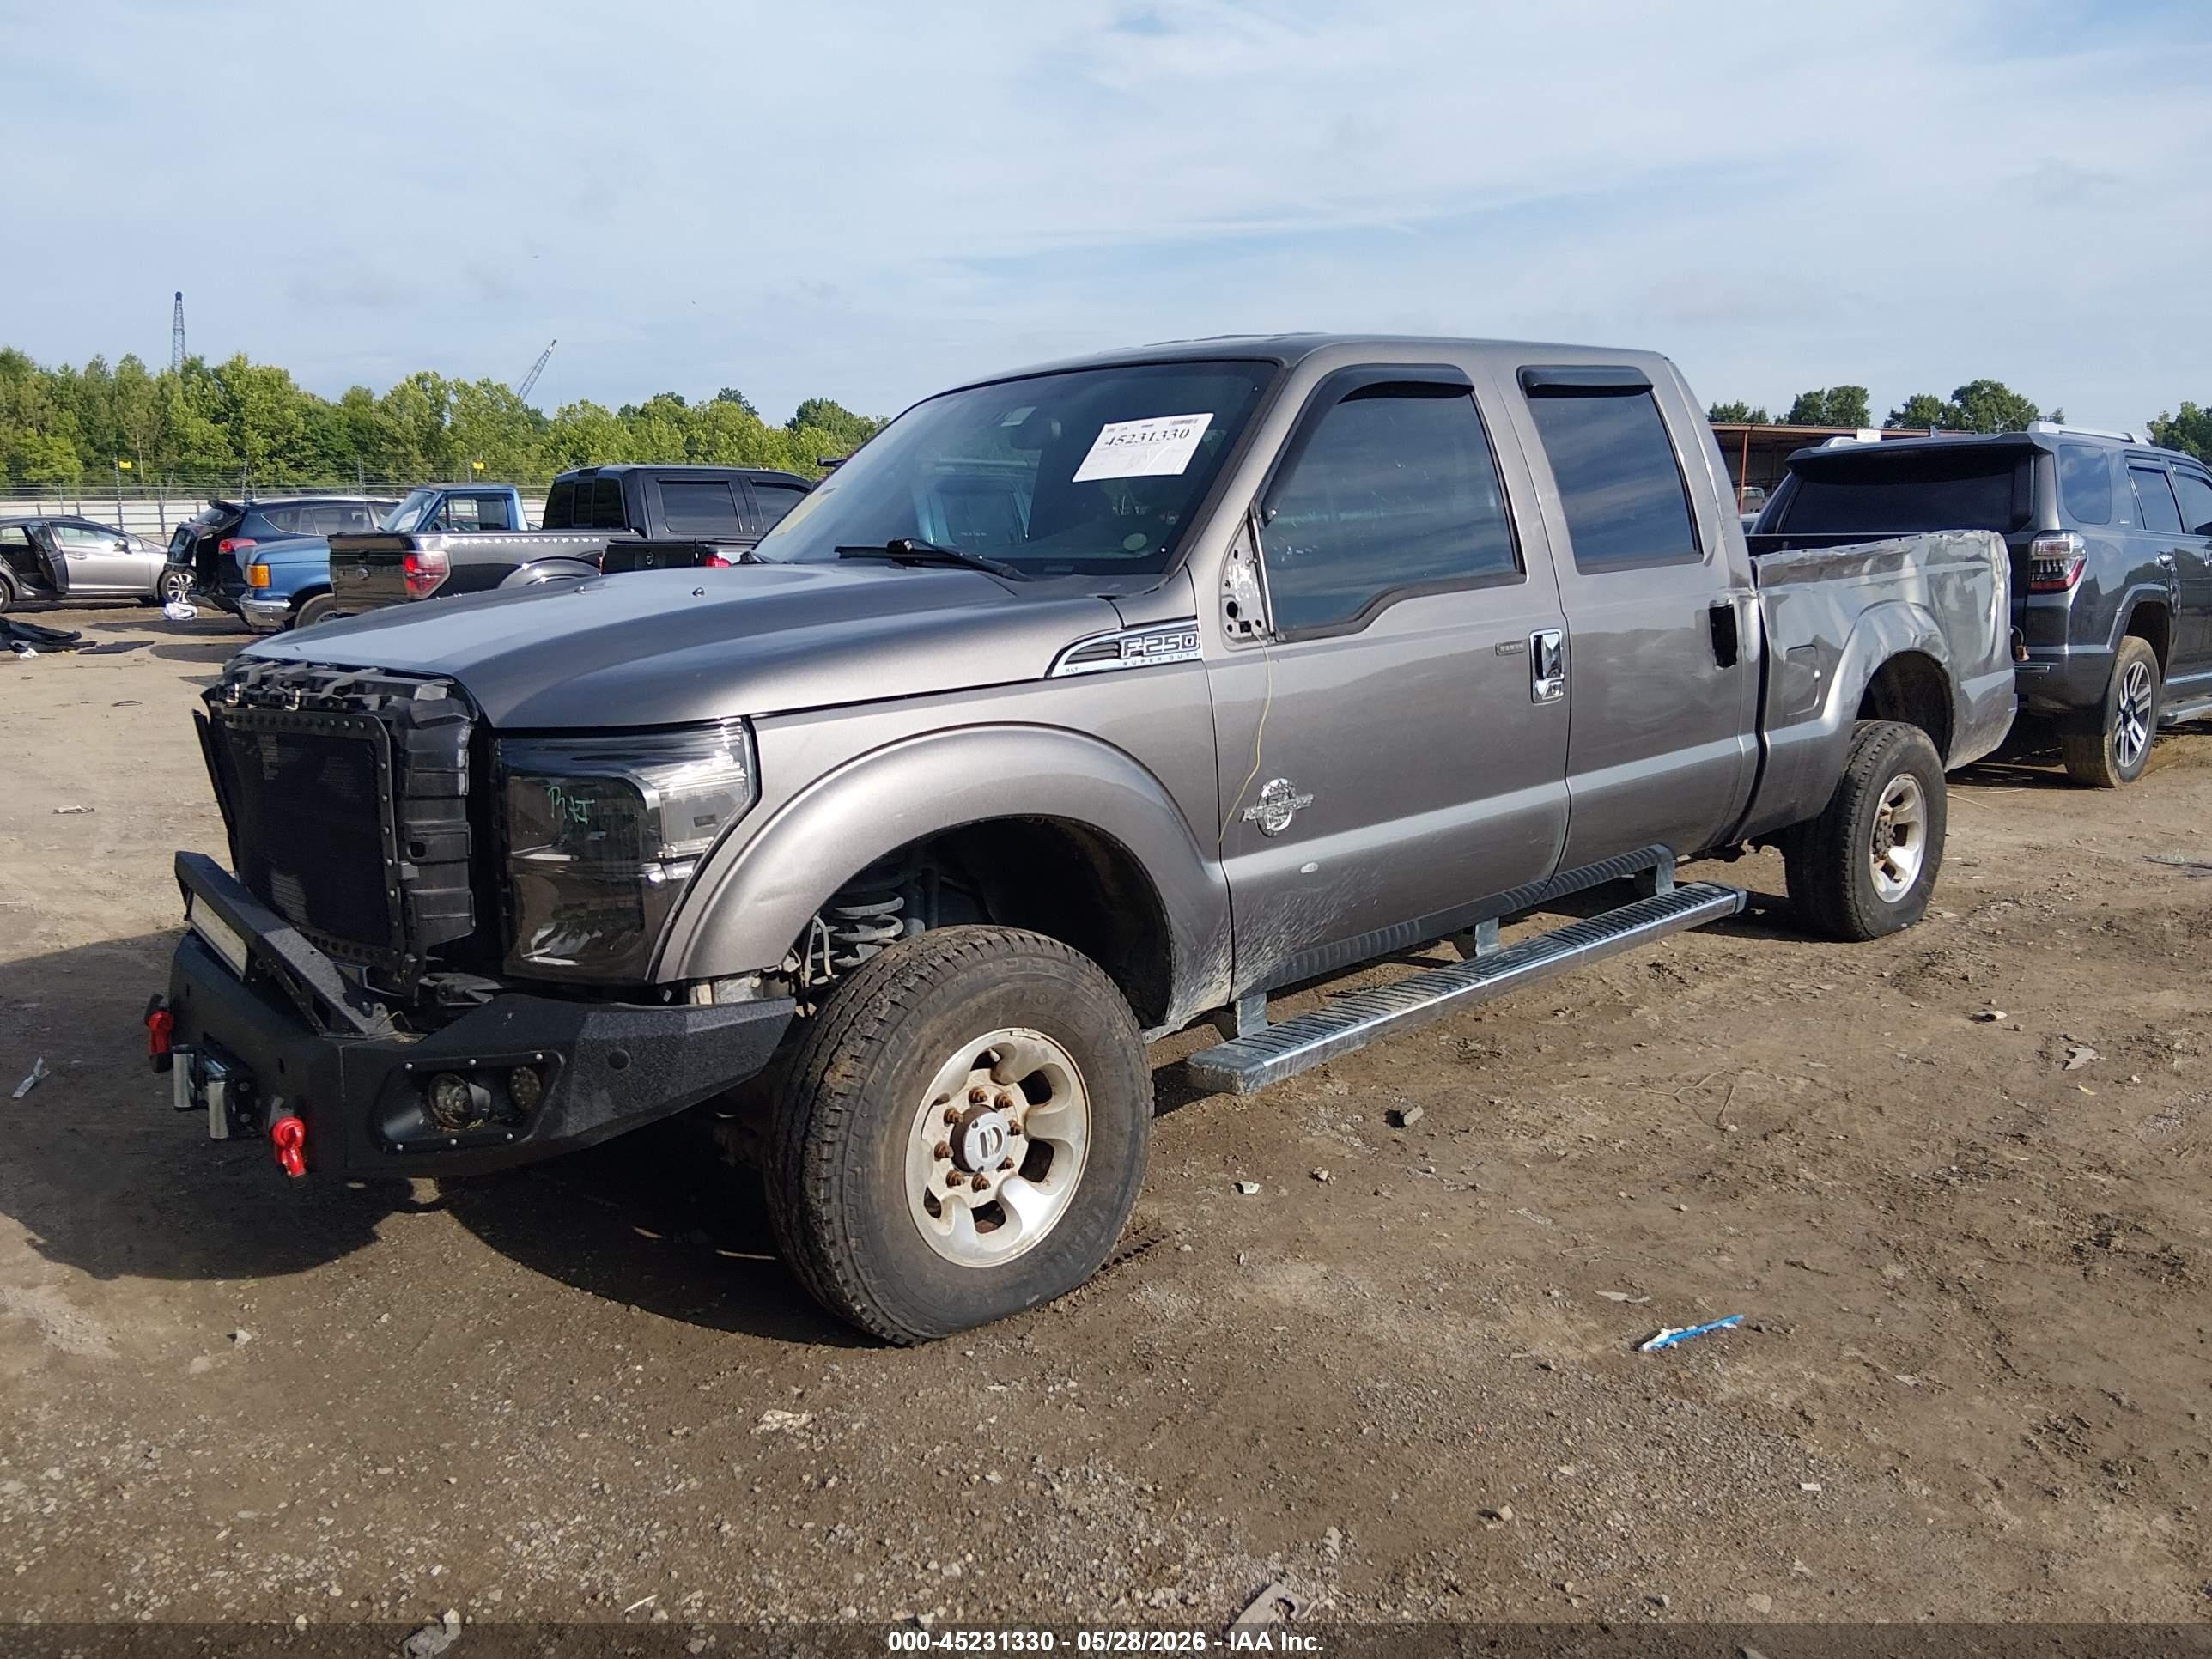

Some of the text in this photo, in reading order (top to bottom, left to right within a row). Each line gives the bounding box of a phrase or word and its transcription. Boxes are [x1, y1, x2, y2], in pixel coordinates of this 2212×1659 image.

[1104, 428, 1190, 447] 45231330
[1119, 631, 1200, 659] F-250
[1169, 652, 1199, 660] DUTY
